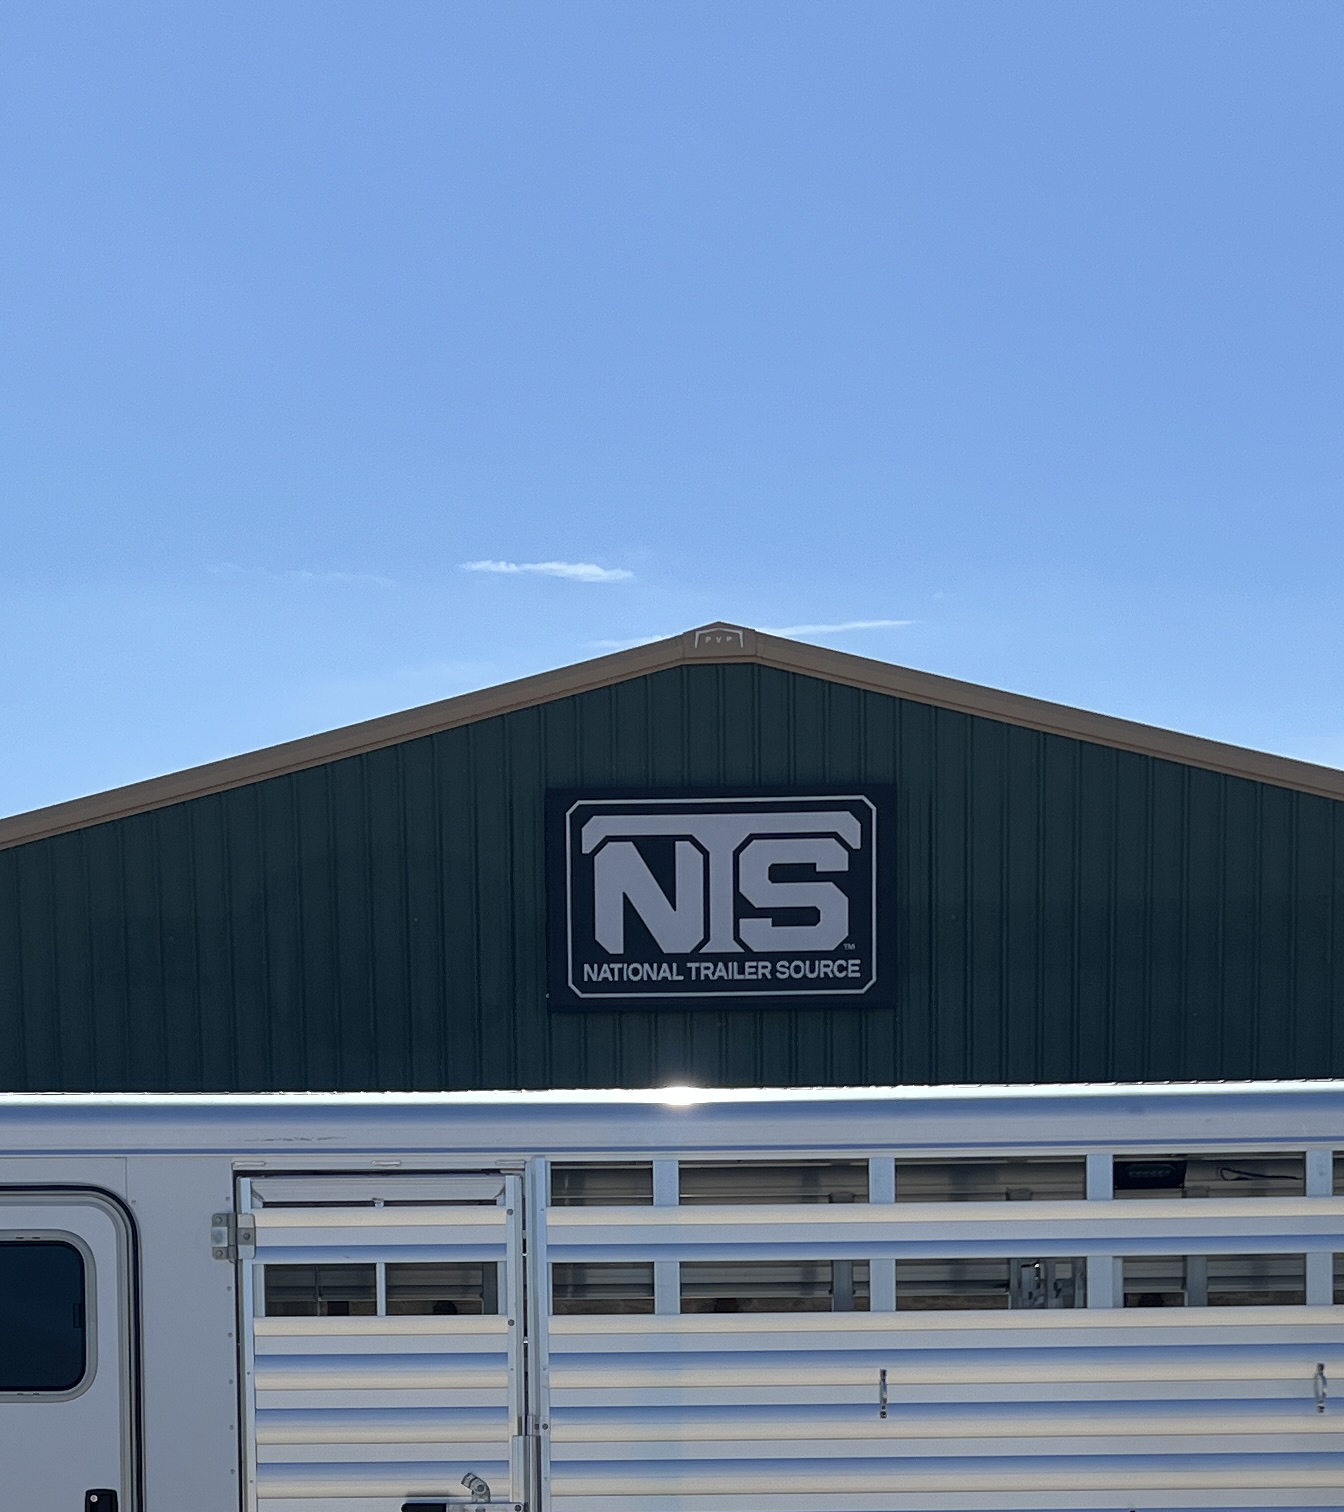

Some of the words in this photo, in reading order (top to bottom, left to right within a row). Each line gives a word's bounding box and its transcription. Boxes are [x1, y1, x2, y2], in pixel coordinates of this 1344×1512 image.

[581, 810, 862, 955] NTS
[583, 961, 684, 982] NATIONAL
[686, 960, 772, 981] TRAILER
[775, 959, 861, 979] SOURCE
